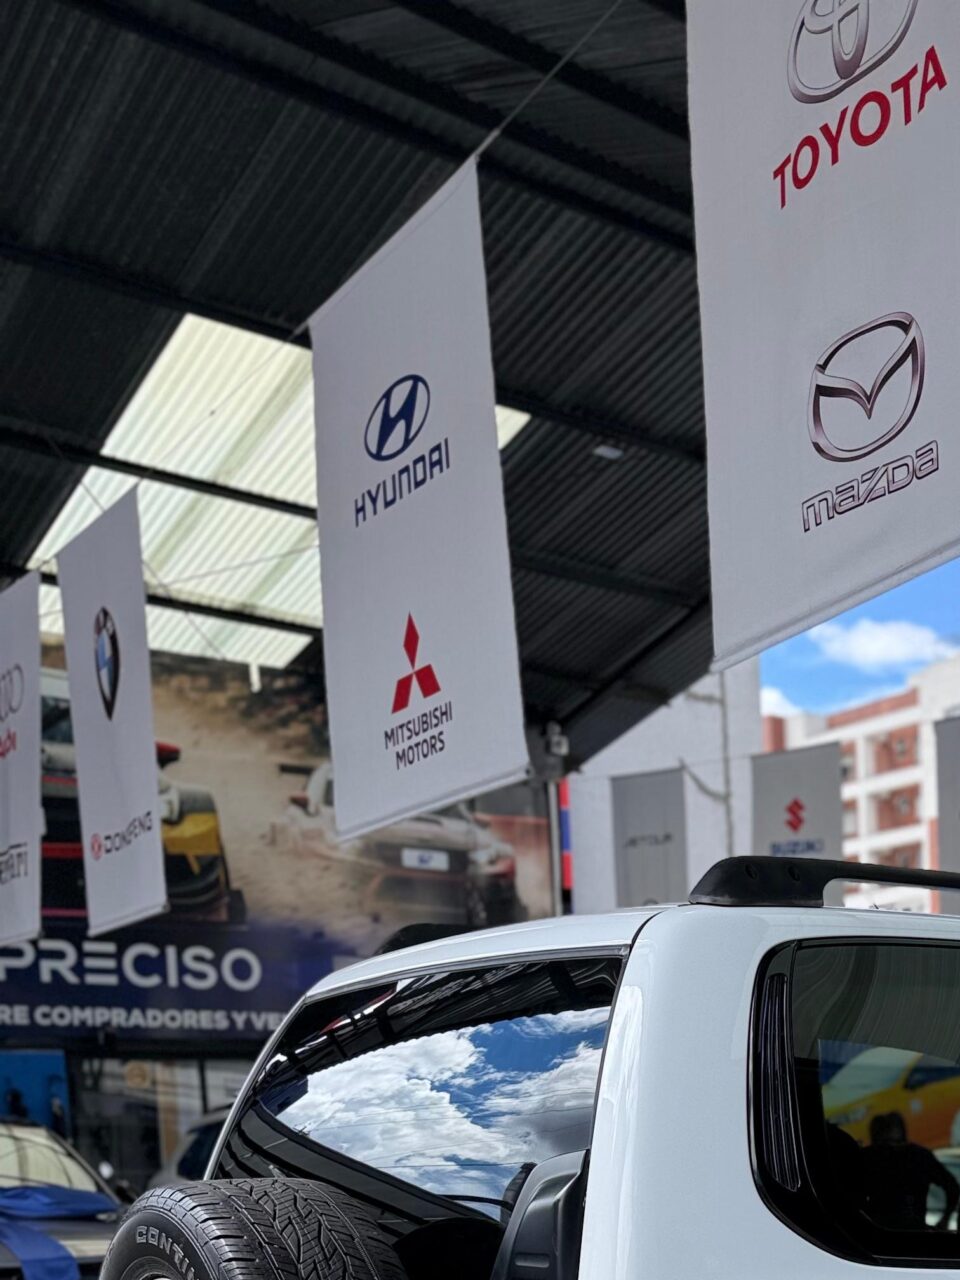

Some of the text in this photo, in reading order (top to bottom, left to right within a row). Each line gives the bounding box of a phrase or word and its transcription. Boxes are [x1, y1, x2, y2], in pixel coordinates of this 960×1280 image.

[772, 45, 947, 210] TOYOTA
[354, 438, 451, 528] HYUNDAI
[383, 701, 453, 750] MITSUBISHI
[395, 731, 446, 771] MOTORS
[0, 939, 262, 992] PRECISO
[34, 1004, 229, 1031] COMPRADORES
[230, 1011, 247, 1031] Y
